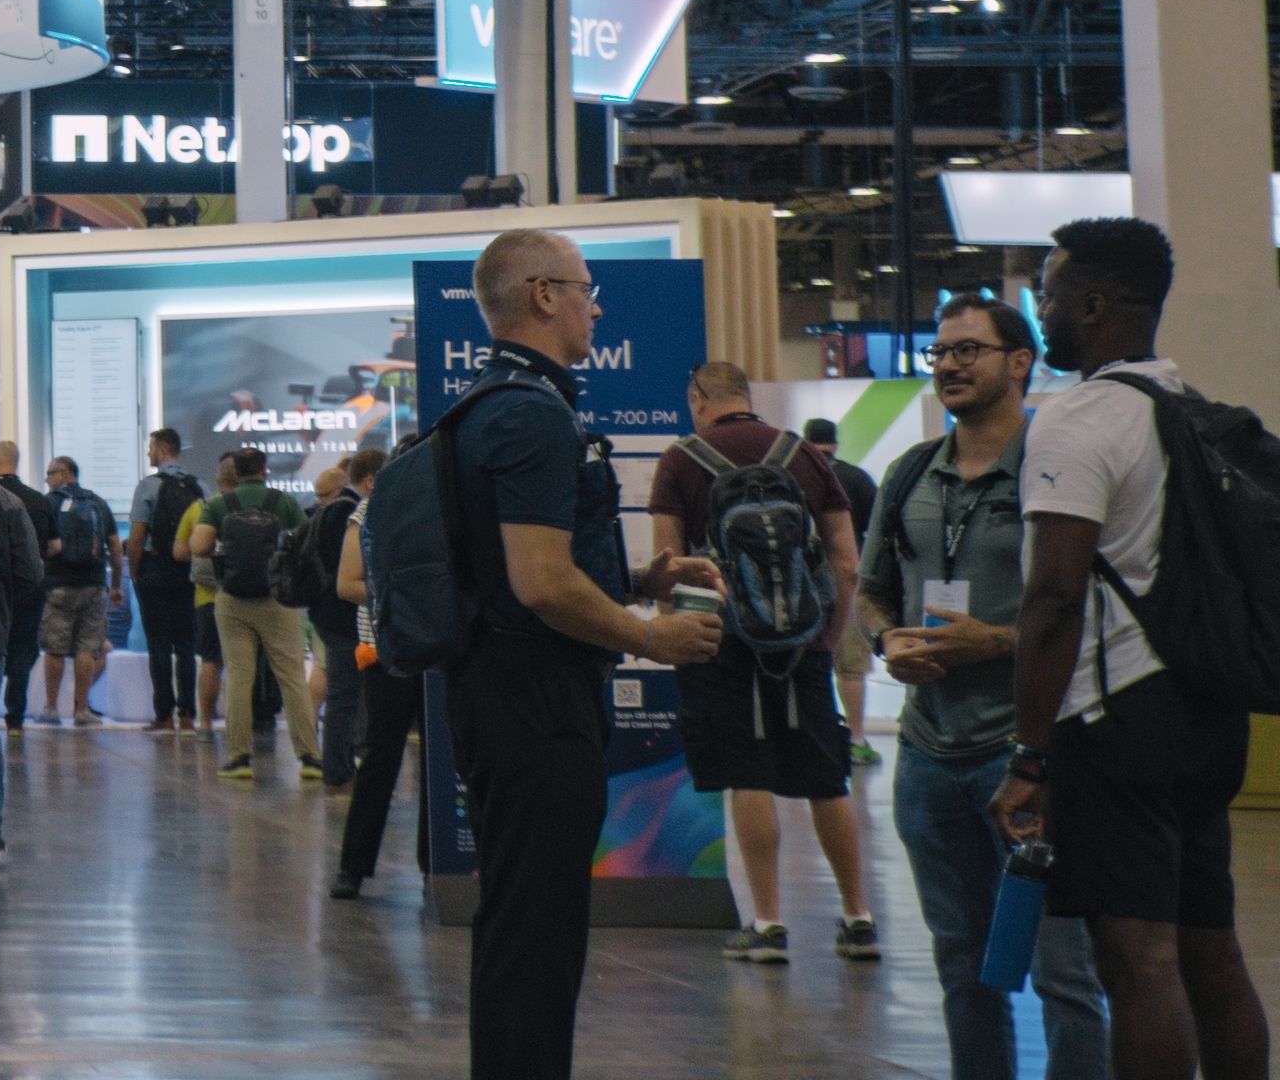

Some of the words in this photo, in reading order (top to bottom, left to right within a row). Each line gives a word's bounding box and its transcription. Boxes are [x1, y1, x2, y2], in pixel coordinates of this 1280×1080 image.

[444, 341, 493, 371] Ha
[212, 409, 358, 433] McLaren
[613, 410, 648, 426] 7:00
[652, 410, 677, 425] PM
[323, 440, 358, 453] TEAM
[265, 479, 315, 493] OFFICIA
